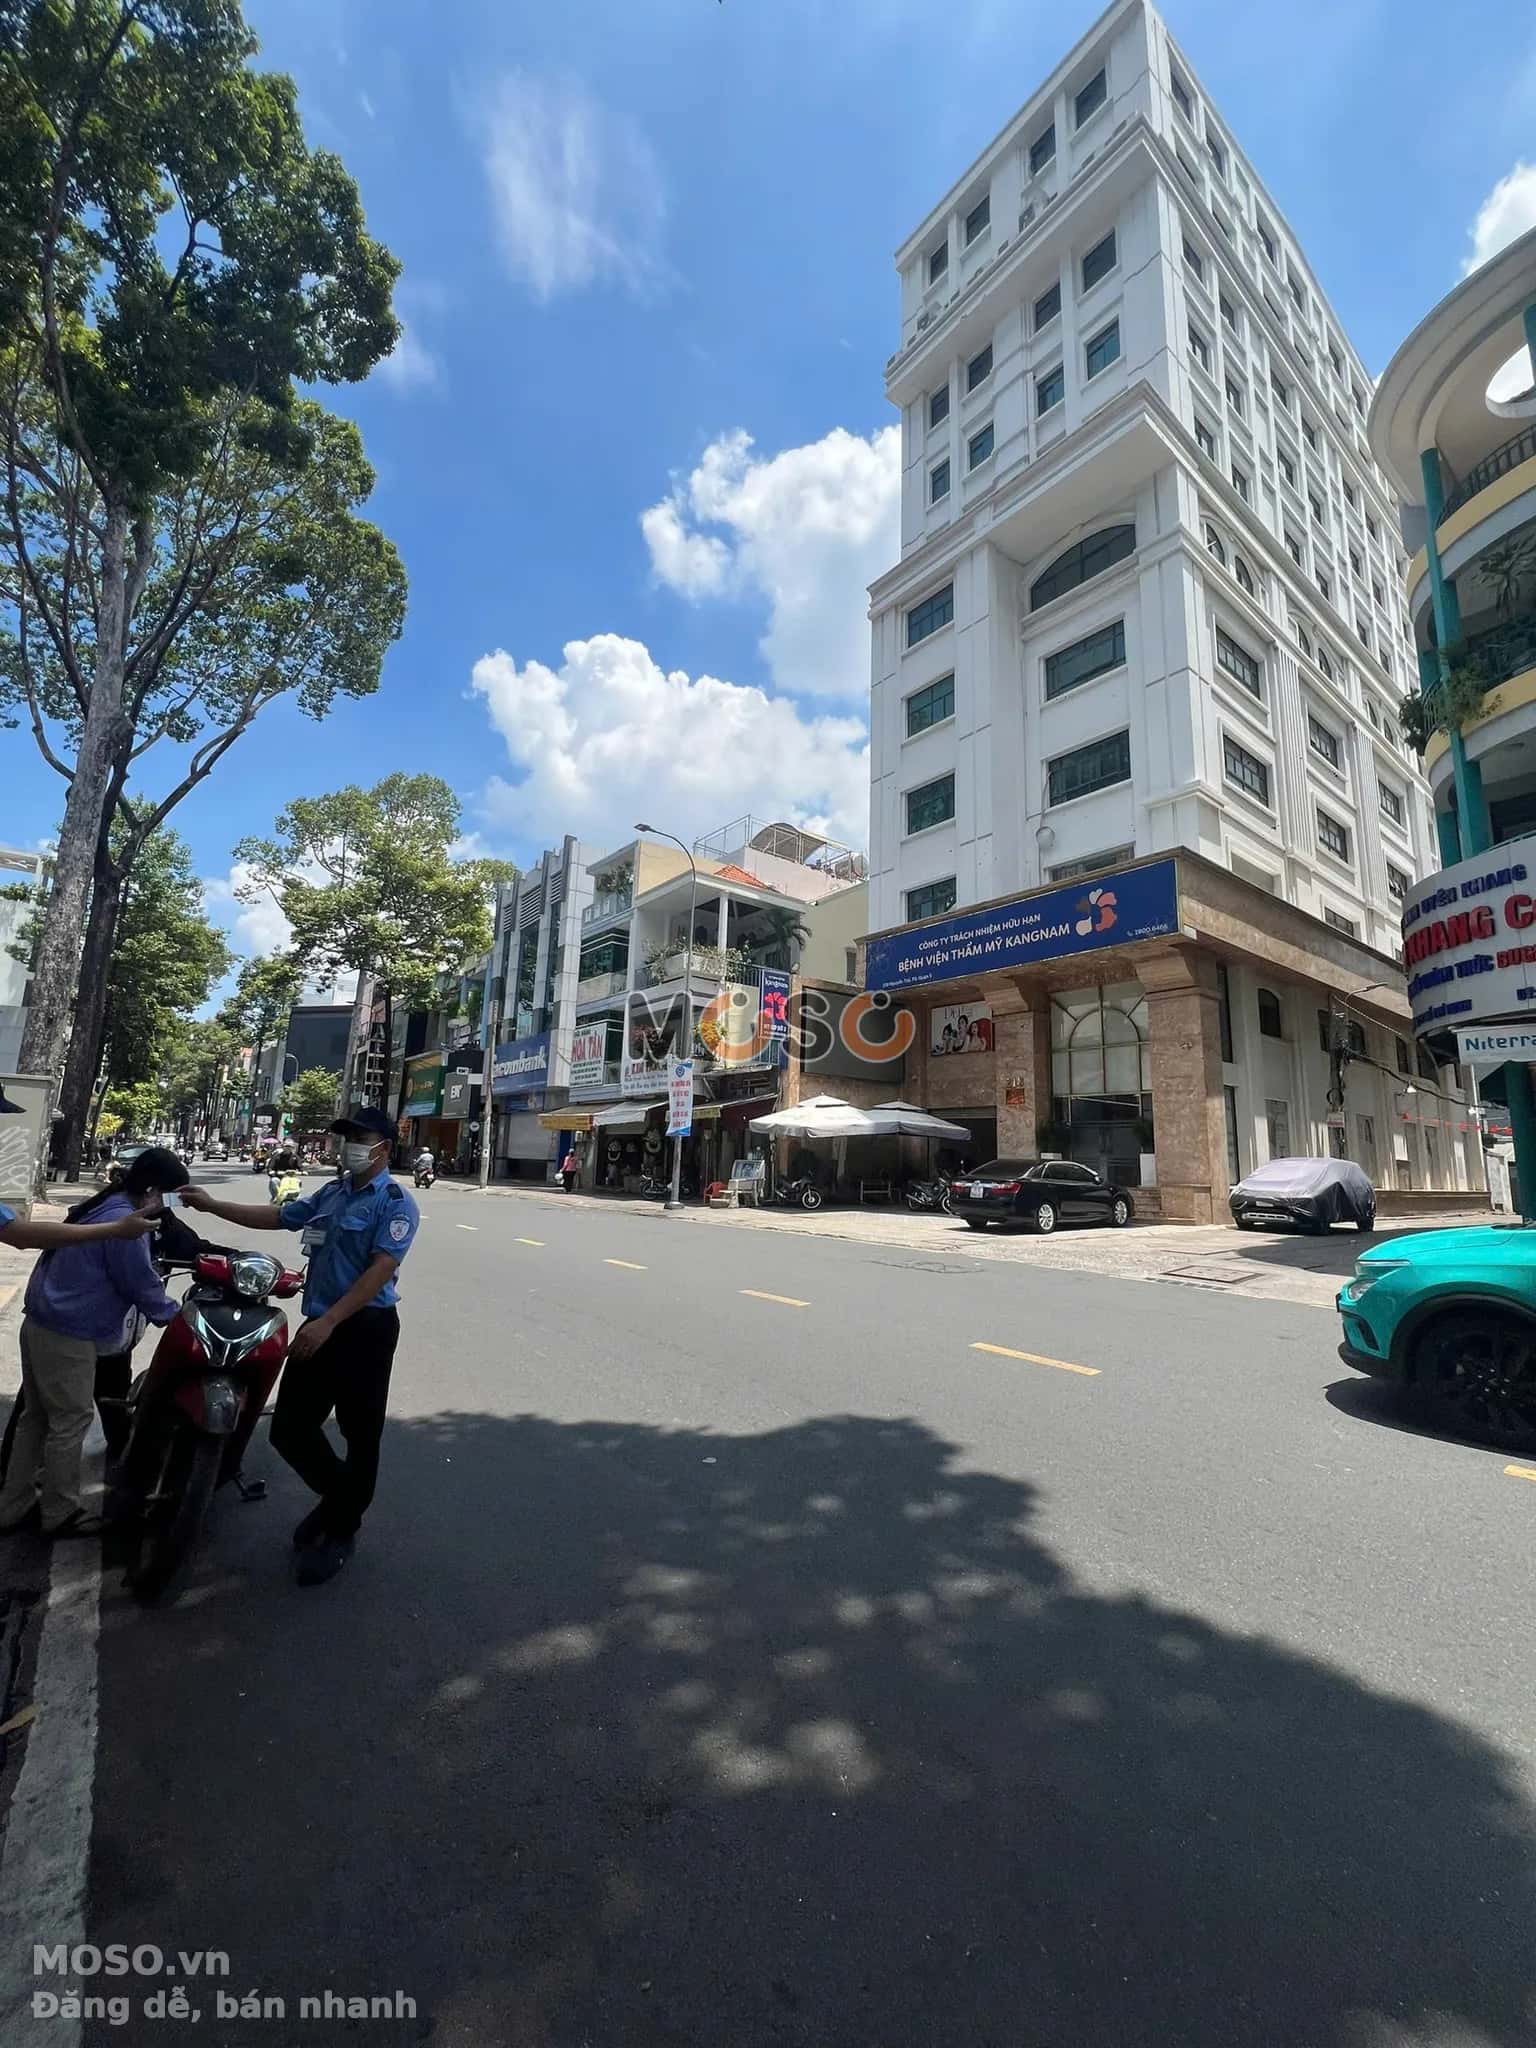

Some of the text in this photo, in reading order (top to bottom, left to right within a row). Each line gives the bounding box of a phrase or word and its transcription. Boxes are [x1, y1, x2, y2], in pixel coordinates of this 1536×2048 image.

[1504, 894, 1536, 929] C
[898, 923, 1071, 973] BỆNH VIỆN THẨM MỸ KANGNAM
[918, 913, 1041, 951] CÔNG TY TRÁCH NHIỆM HỮU HẠN
